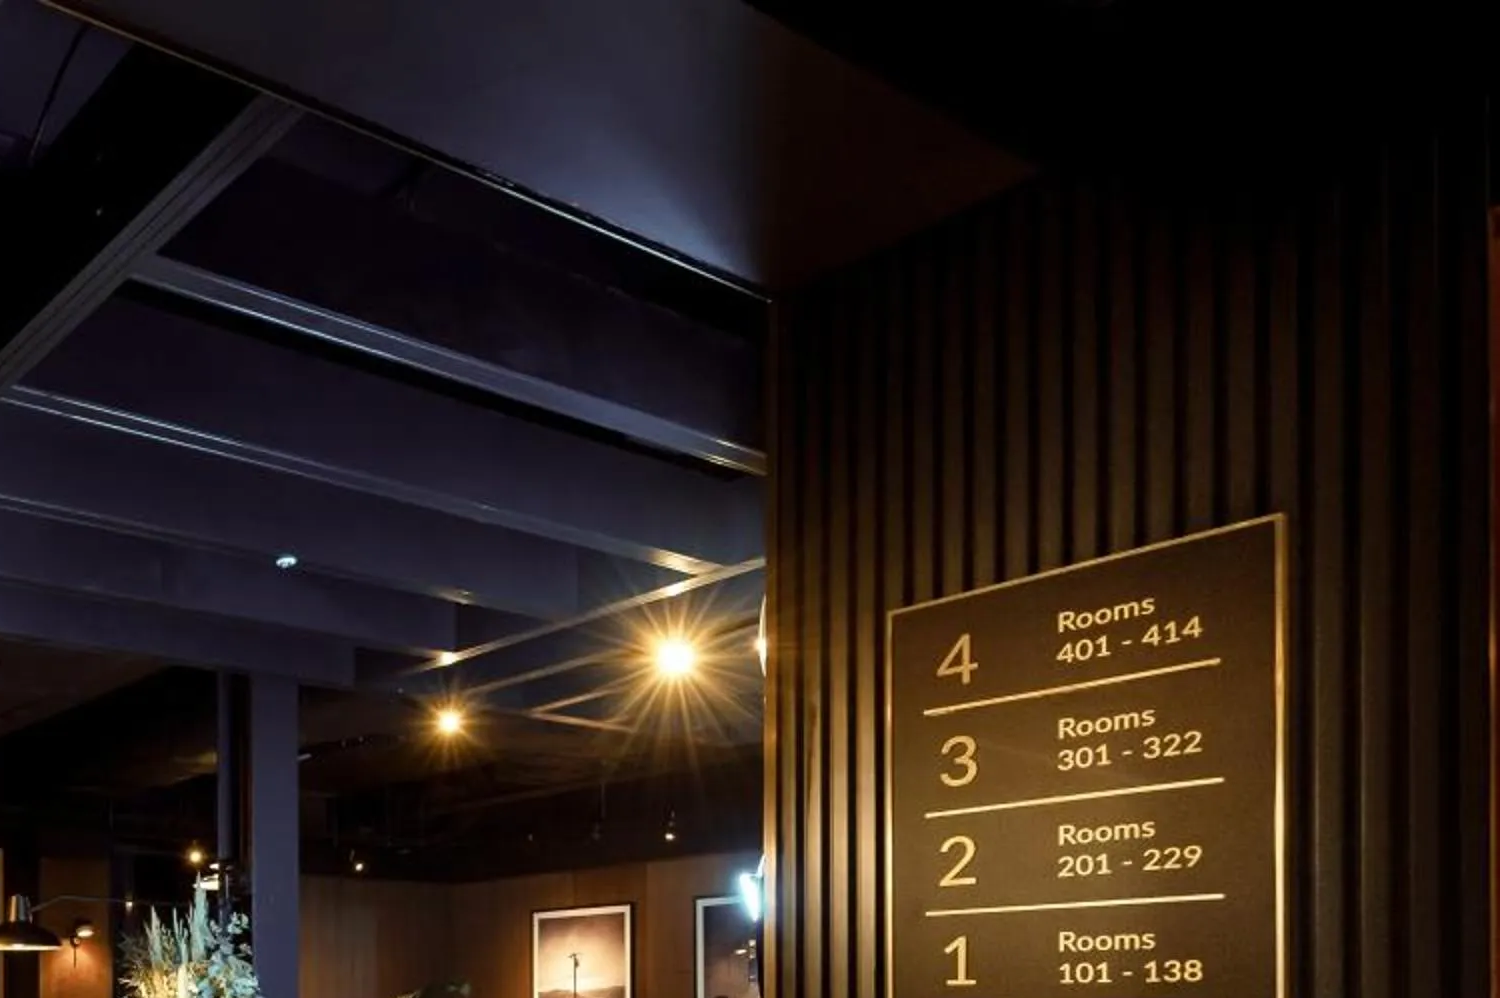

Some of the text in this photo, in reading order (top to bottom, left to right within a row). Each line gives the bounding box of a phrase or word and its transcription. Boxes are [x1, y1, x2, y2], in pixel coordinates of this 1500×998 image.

[1057, 597, 1156, 633] Rooms
[1056, 634, 1112, 664] 401
[1141, 615, 1203, 647] 414
[936, 633, 979, 685] 4
[1058, 709, 1156, 740] Rooms
[940, 735, 978, 787] 3
[1057, 743, 1112, 771] 301
[1143, 730, 1203, 759] 322
[1058, 821, 1156, 846] Rooms
[939, 835, 977, 887] 2
[1057, 853, 1112, 878] 201
[1142, 844, 1203, 871] 229
[943, 935, 977, 986] 1
[1058, 931, 1156, 953] Rooms
[1059, 961, 1113, 984] 101
[1143, 959, 1204, 983] 138
